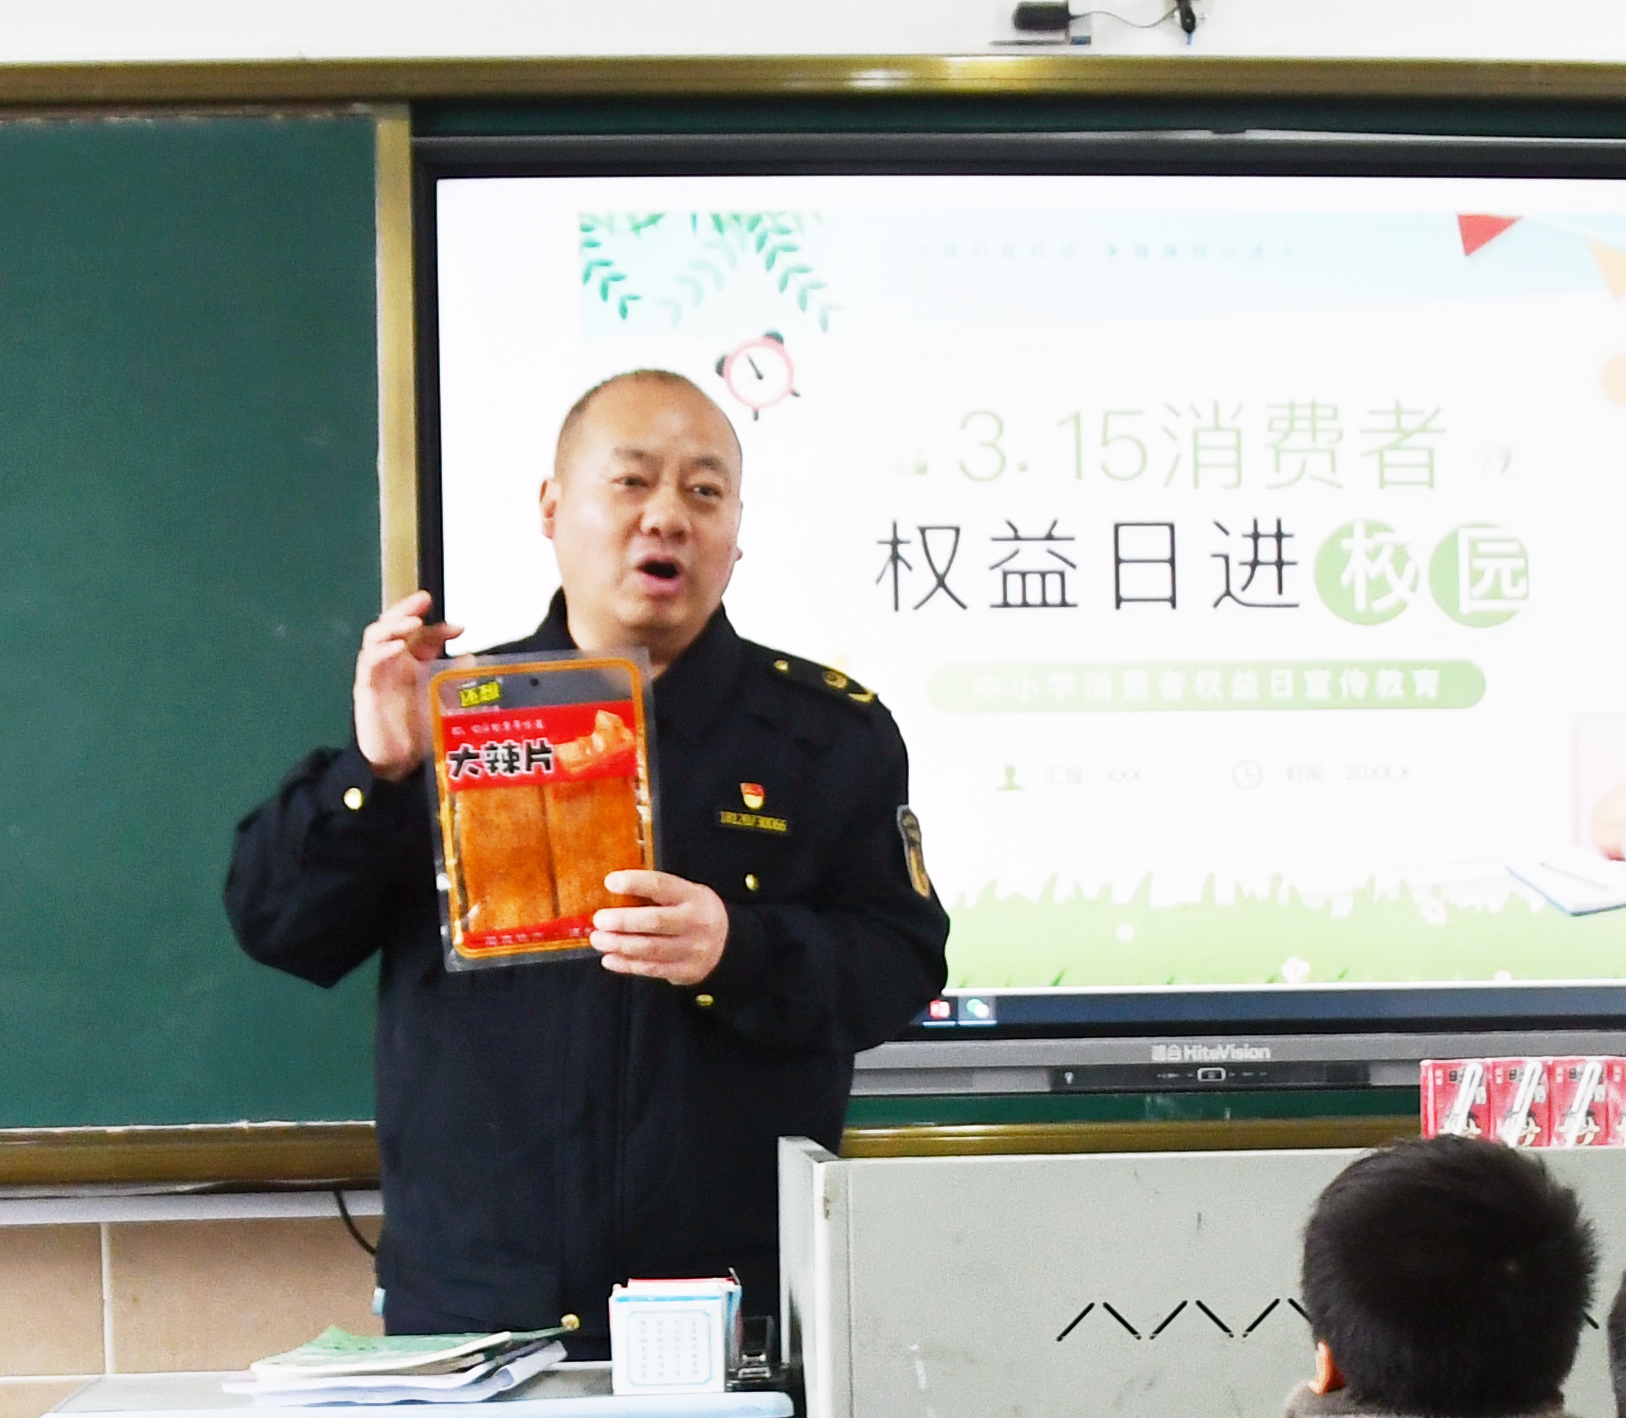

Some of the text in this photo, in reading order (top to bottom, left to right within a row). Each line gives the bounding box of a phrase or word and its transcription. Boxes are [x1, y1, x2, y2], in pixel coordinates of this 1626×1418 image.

[875, 518, 1529, 614] 权益日进校园
[973, 666, 1441, 704] 中小学消费者权益日宣传教育
[449, 738, 554, 780] 大辣片
[1183, 1043, 1272, 1061] HiteVision
